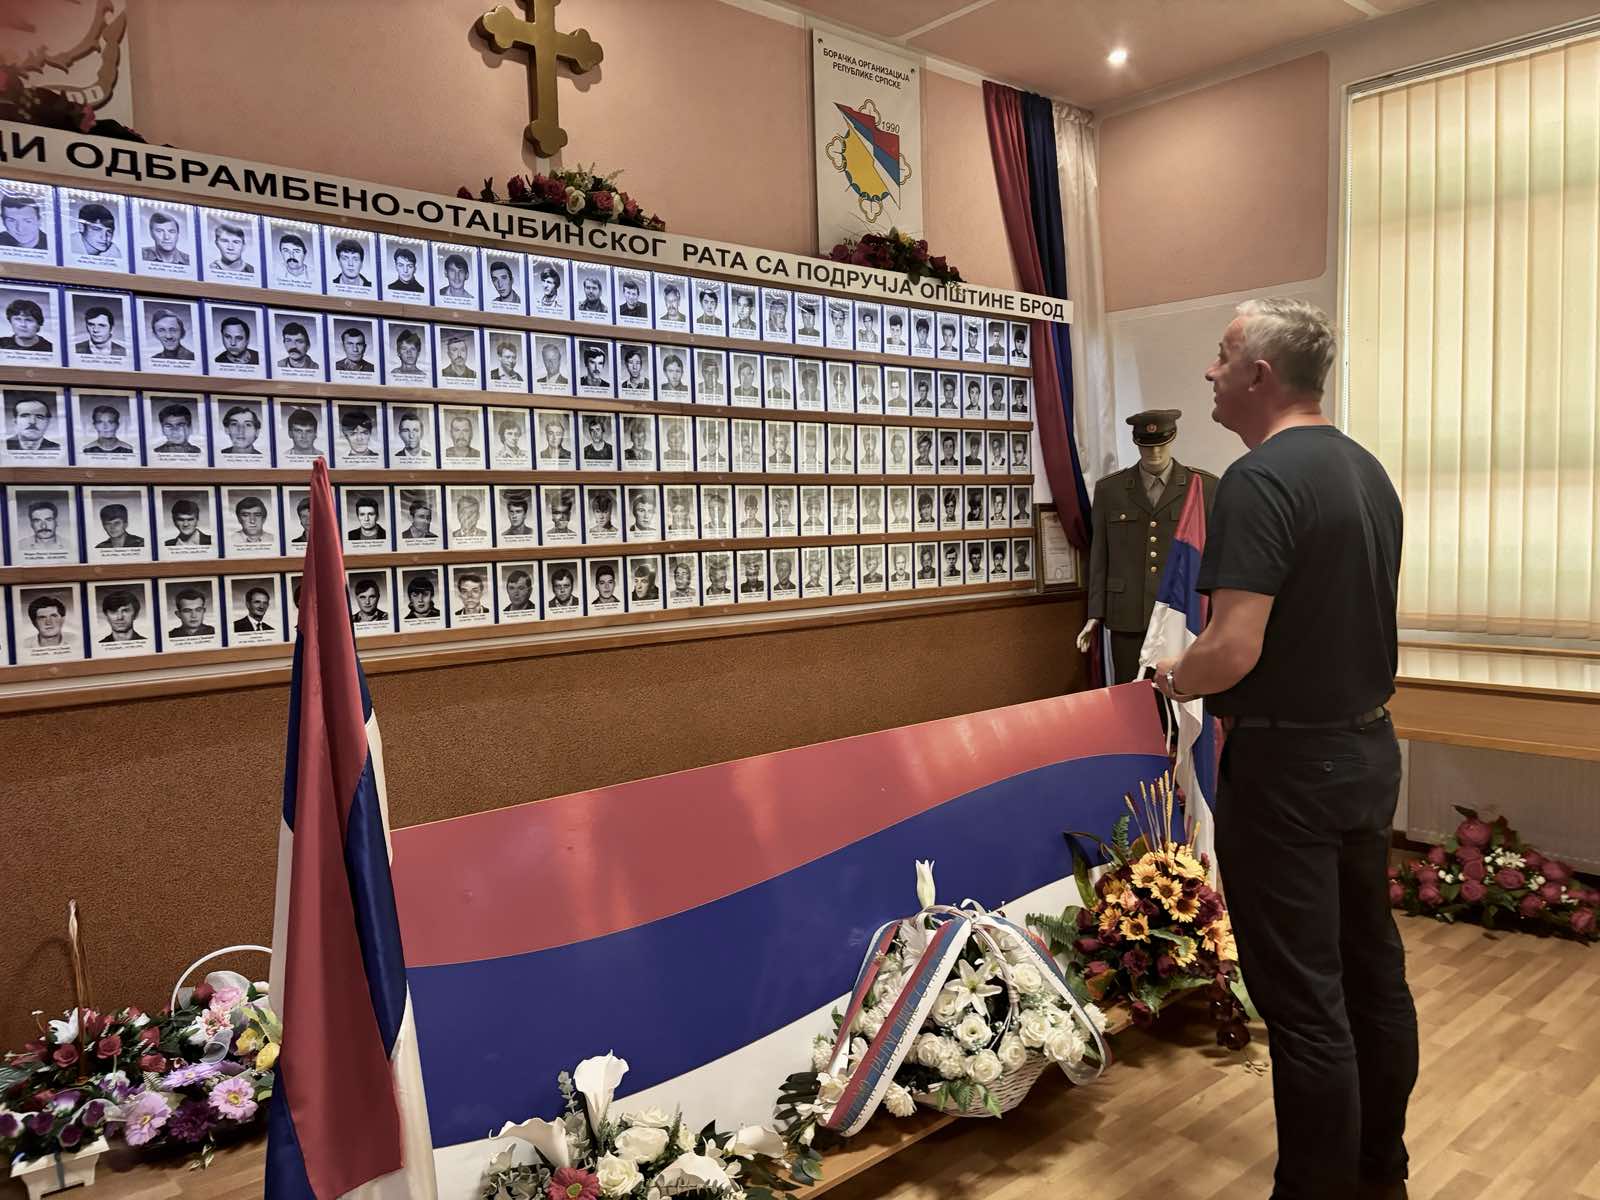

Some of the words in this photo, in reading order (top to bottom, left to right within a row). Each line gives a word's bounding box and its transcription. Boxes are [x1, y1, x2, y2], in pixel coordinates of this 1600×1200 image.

[823, 48, 857, 66] БОРАЧКА
[858, 59, 910, 81] ОРГАНИЗАЦИЈА
[832, 61, 873, 81] РЕПУБЛИКЕ
[874, 75, 901, 90] СРПСКЕ
[881, 121, 900, 133] 1990
[66, 141, 666, 257] ОДБРАМБЕНО-ОТАЏБИНСКОГ
[682, 242, 747, 271] РАТА
[755, 254, 789, 277] СА
[797, 262, 914, 297] ПОДРУЧЈА
[920, 282, 1015, 311] ОПШТИНЕ
[1020, 297, 1065, 321] БРОД
